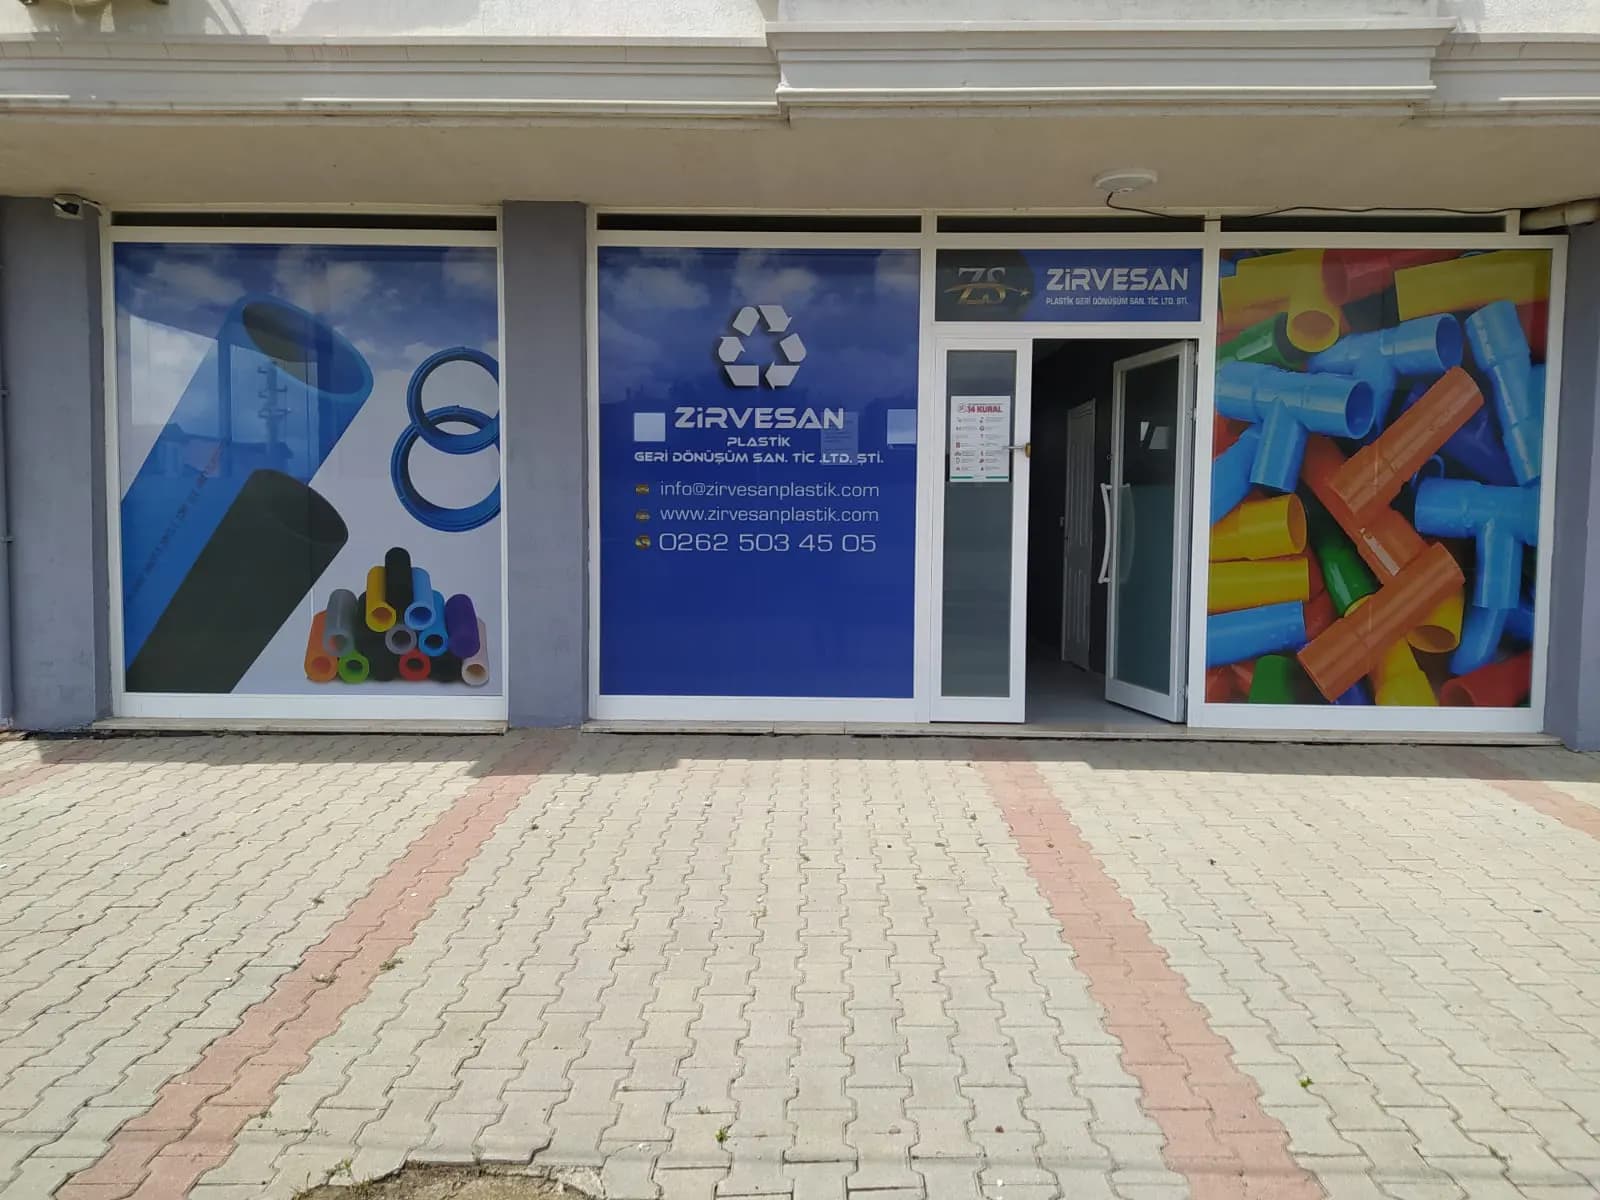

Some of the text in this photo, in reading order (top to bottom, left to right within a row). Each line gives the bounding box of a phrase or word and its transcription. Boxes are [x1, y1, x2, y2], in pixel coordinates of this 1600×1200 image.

[976, 405, 1003, 413] KURAL
[726, 434, 791, 448] PLASTİK
[633, 449, 669, 463] GERİ
[672, 449, 749, 465] DÖNÜŞÜM
[752, 452, 788, 464] SAN.
[660, 480, 880, 500] info@zirvesanplastik.com
[660, 506, 880, 524] www.zirvesanplastik.com
[659, 533, 877, 553] 0262 503 45 05
